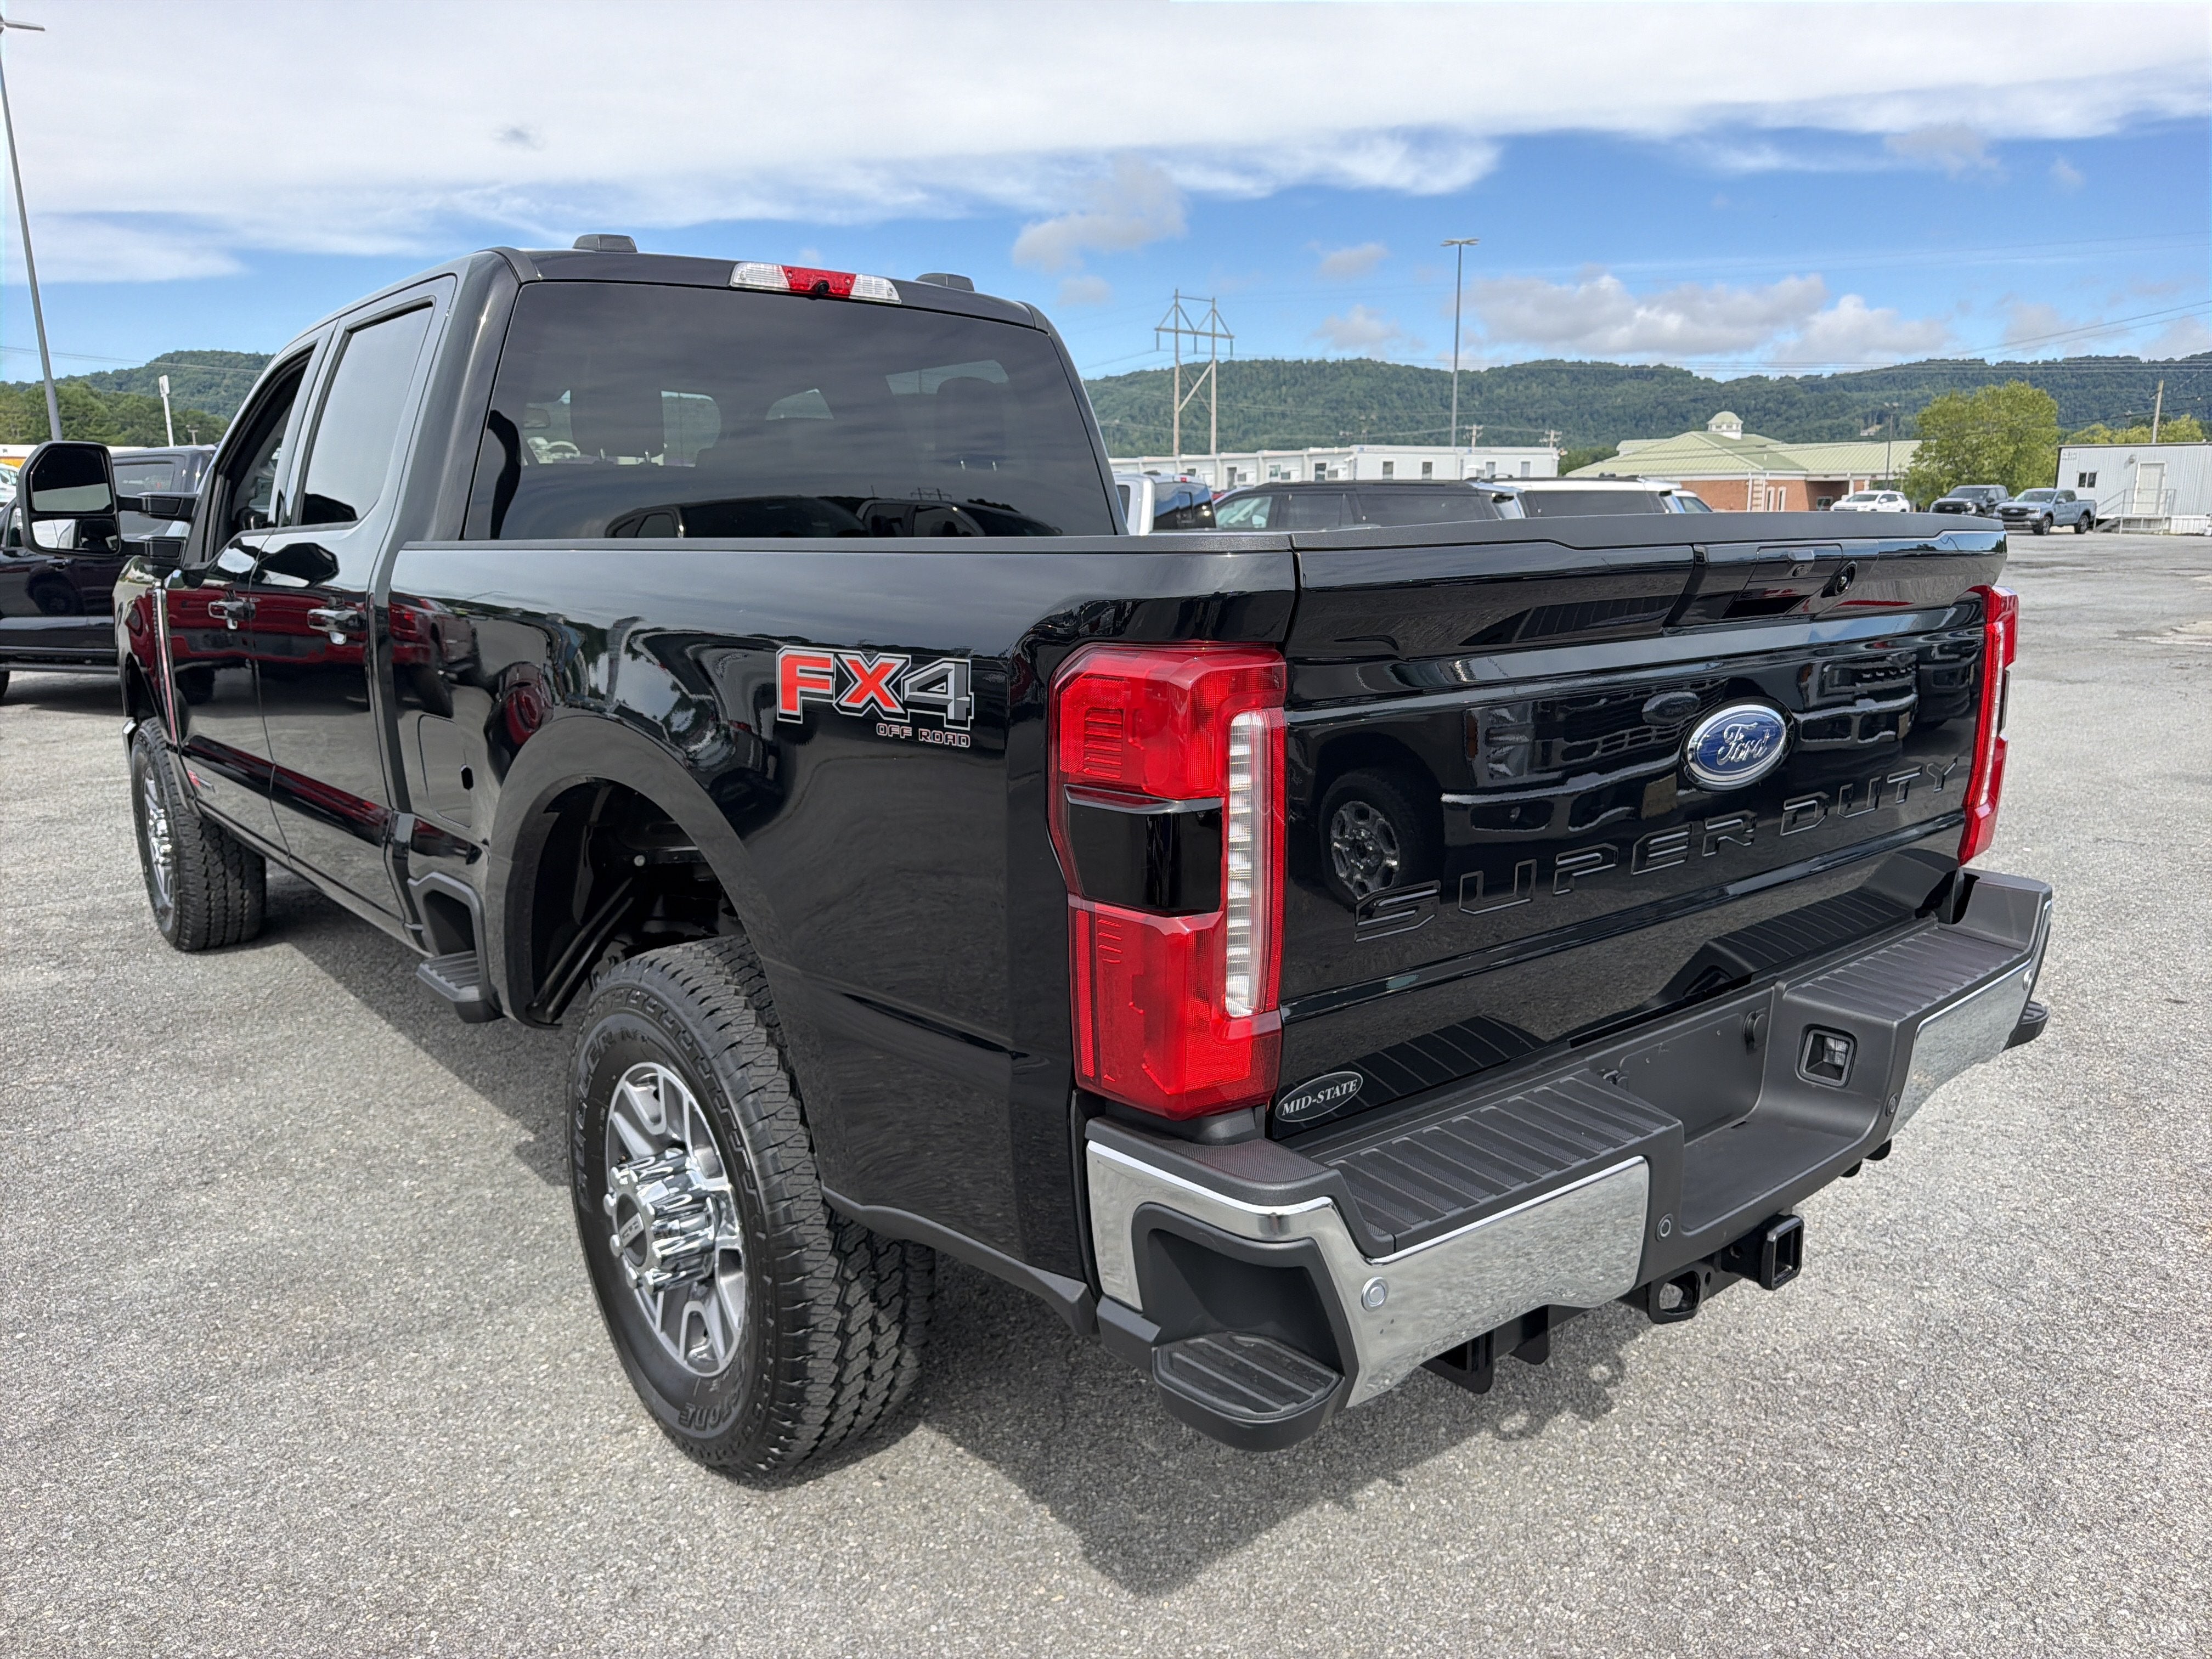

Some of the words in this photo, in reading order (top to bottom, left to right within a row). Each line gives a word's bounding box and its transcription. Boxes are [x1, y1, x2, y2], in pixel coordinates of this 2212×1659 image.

[776, 645, 974, 731] FX4
[876, 723, 912, 740] OFF
[918, 727, 970, 748] ROAD
[1716, 721, 1771, 766] Ford
[1354, 809, 1757, 943] SUPER
[1780, 756, 1959, 837] DUTY
[1282, 1079, 1358, 1116] MID-STATE
